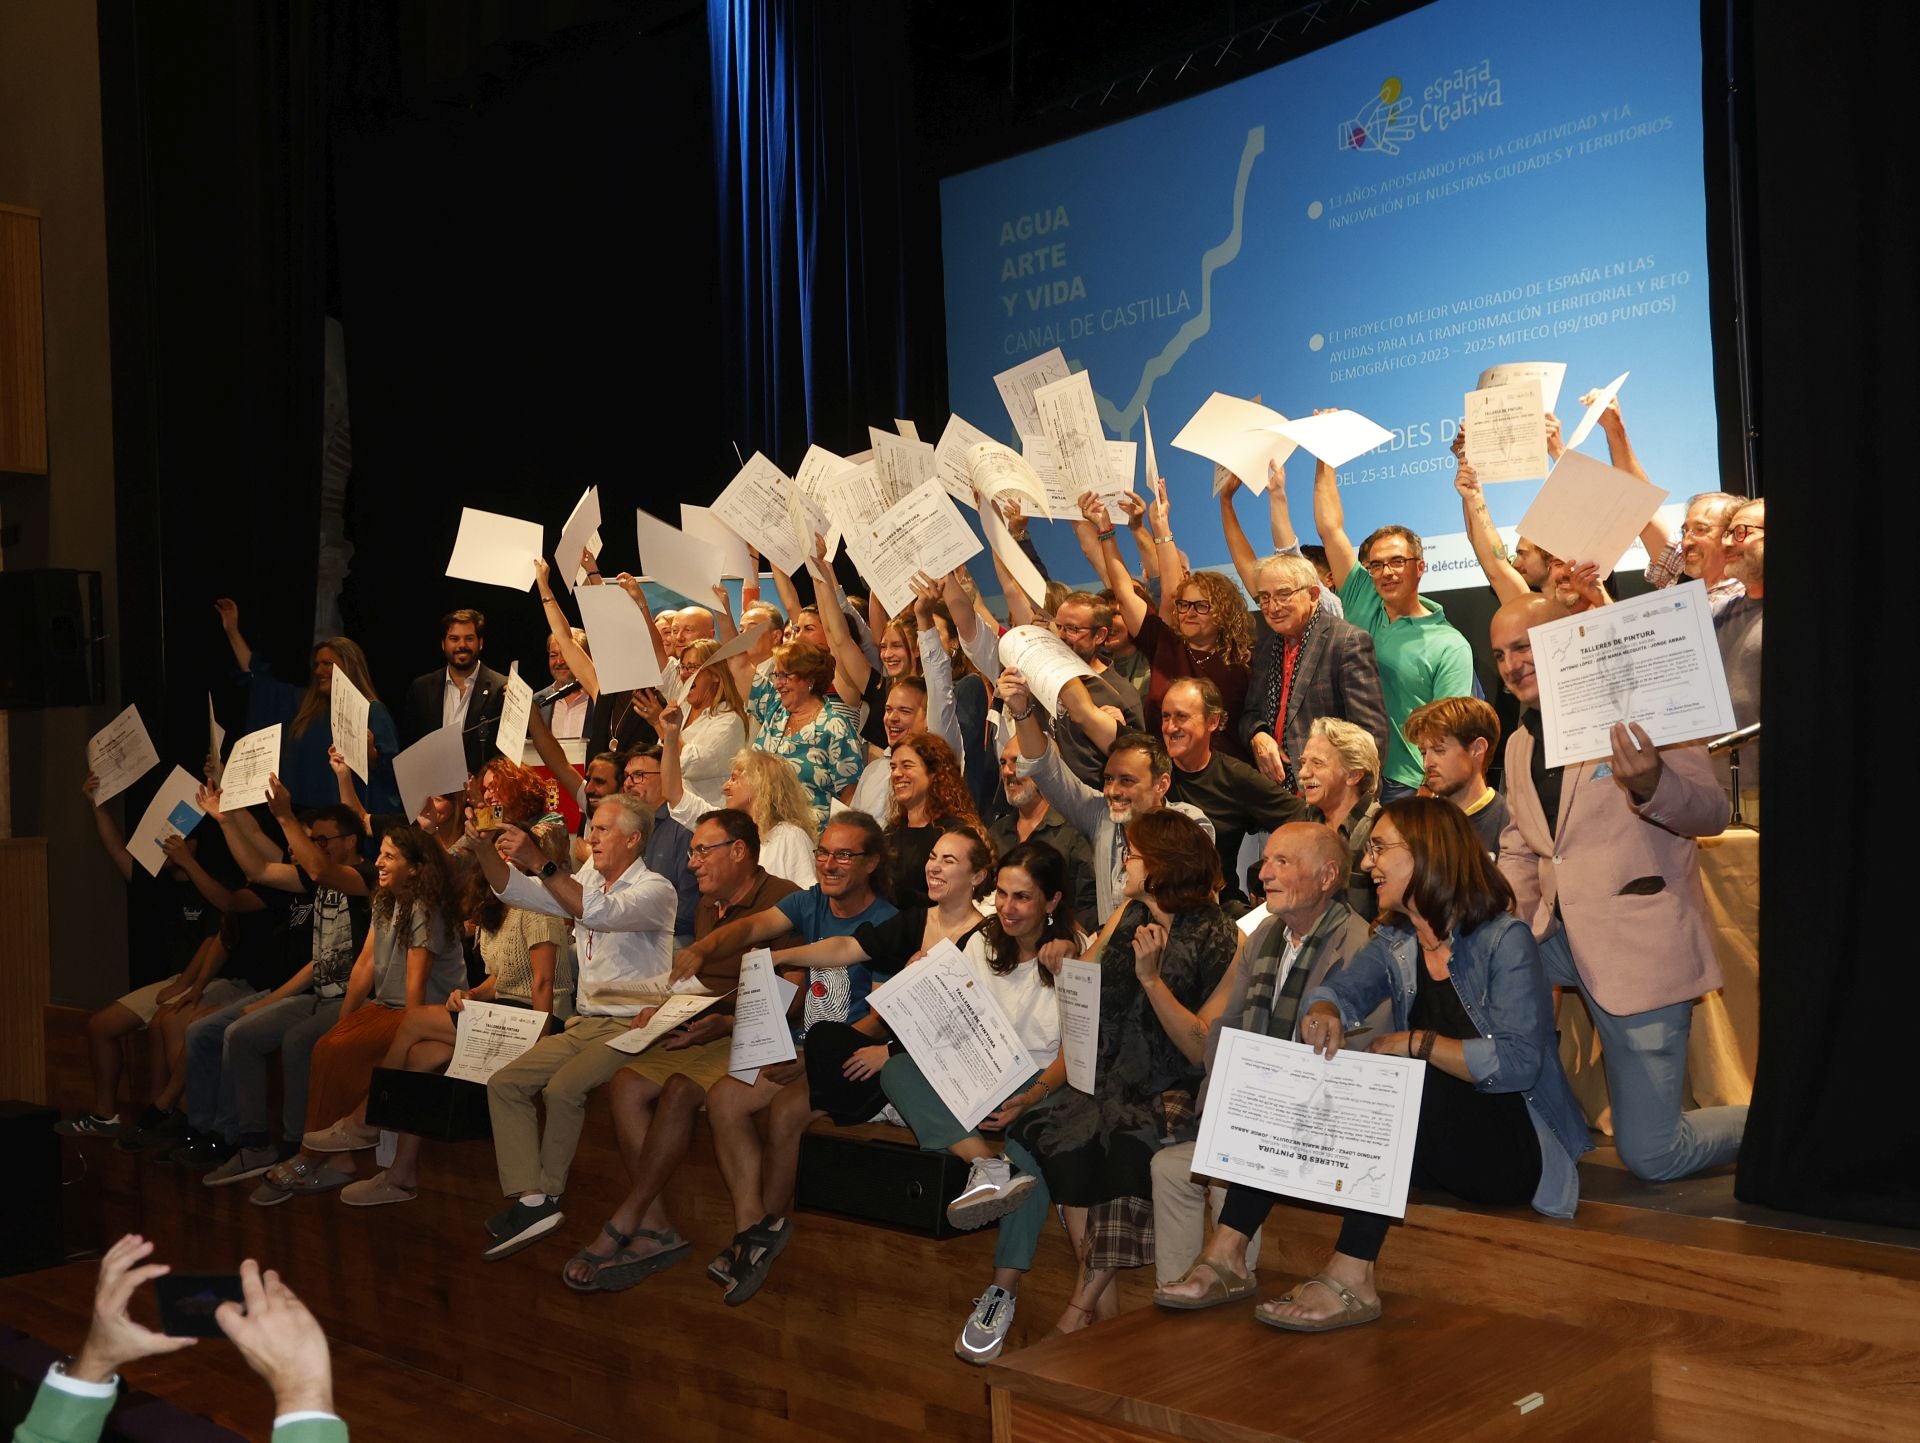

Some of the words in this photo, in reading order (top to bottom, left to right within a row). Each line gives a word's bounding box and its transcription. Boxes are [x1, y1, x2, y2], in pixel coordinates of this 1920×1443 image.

[1424, 59, 1491, 102] españa
[1420, 79, 1503, 132] Creativa
[1329, 197, 1342, 209] 13
[1344, 185, 1377, 208] AÑOS
[1380, 160, 1455, 193] APOSTANDO
[1459, 152, 1484, 170] POR
[1489, 143, 1504, 160] LA
[1507, 114, 1598, 154] CREATIVIDAD
[1600, 110, 1610, 124] Y
[1614, 104, 1632, 121] LA
[1329, 201, 1403, 230] INNOVACIÓN
[1407, 193, 1421, 208] DE
[1426, 173, 1491, 201] NUESTRAS
[1494, 150, 1563, 181] CIUDADES
[1565, 145, 1574, 159] Y
[1578, 115, 1673, 155] TERRITORIOS
[999, 205, 1069, 246] AGUA
[1001, 243, 1067, 283] ARTE
[1002, 293, 1018, 317] Y
[1026, 276, 1087, 311] VIDA
[1329, 332, 1341, 344] EL
[1344, 316, 1404, 341] PROYECTO
[1407, 305, 1449, 326] MEJOR
[1451, 287, 1523, 315] VALORADO
[1526, 282, 1543, 297] DE
[1547, 267, 1601, 292] ESPAÑA
[1604, 262, 1625, 278] EN
[1628, 254, 1656, 273] LAS
[1329, 344, 1374, 364] AYUDAS
[1377, 335, 1407, 353] PARA
[1410, 331, 1425, 345] LA
[1429, 304, 1541, 341] TRANFORMACIÓN
[1546, 283, 1633, 315] TERRITORIAL
[1637, 280, 1648, 293] Y
[1651, 271, 1691, 291] RETO
[1004, 322, 1066, 356] CANAL
[1070, 313, 1095, 340] DE
[1101, 288, 1190, 332] CASTILLA
[1330, 353, 1417, 384] DEMOGRÁFICO
[1420, 346, 1449, 364] 2023
[1464, 335, 1496, 355] 2025
[1498, 324, 1550, 347] MITECO
[1553, 311, 1608, 338] (99/100
[1611, 295, 1677, 323] PUNTOS)
[1361, 465, 1396, 483] 25-31
[1400, 455, 1455, 477] AGOSTO
[1580, 640, 1612, 655] TALLERES
[1613, 637, 1622, 645] DE
[1624, 629, 1656, 643] PINTURA
[956, 988, 976, 1018] TALLERES
[973, 1015, 982, 1024] DE
[979, 1023, 996, 1049] PINTURA
[1258, 1144, 1295, 1158] PINTURA
[1296, 1152, 1308, 1161] DE
[1309, 1156, 1349, 1169] TALLERES
